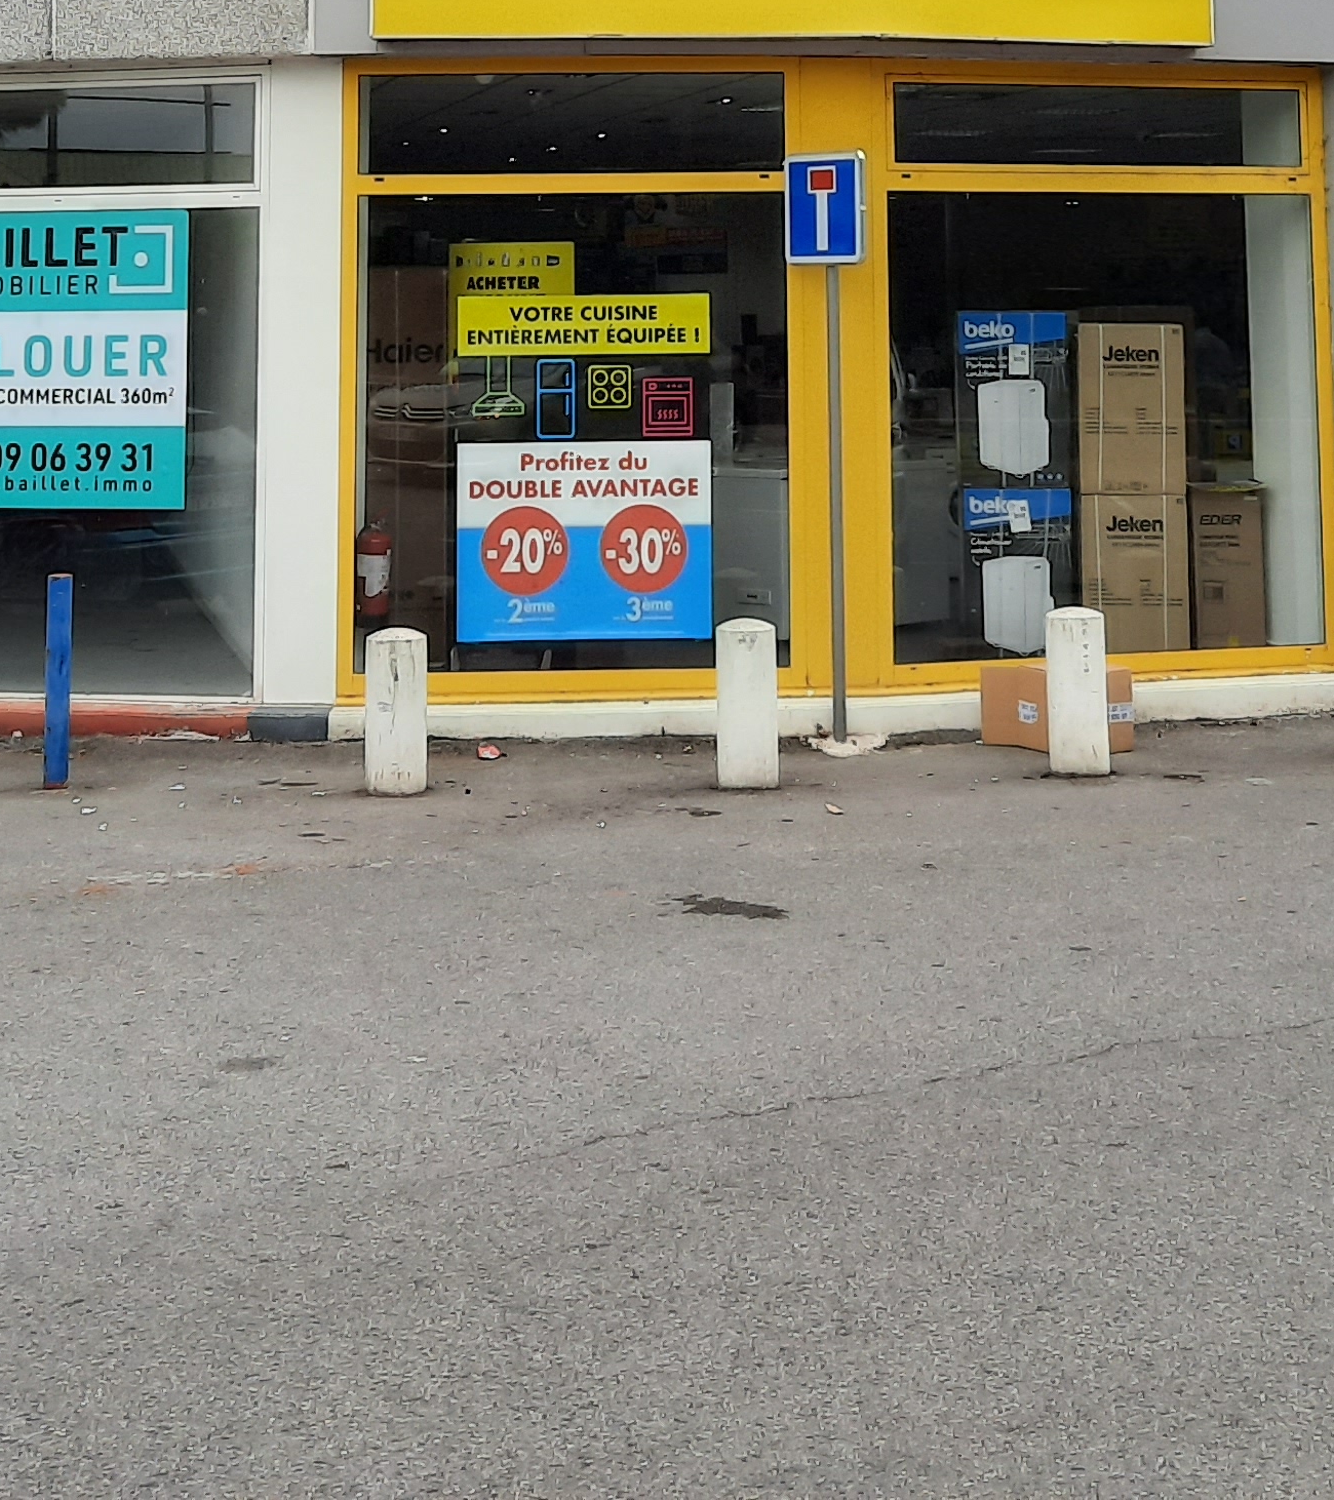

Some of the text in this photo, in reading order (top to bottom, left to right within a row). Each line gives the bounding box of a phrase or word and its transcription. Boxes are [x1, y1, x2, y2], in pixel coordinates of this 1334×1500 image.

[466, 276, 541, 290] ACHETER
[509, 304, 658, 323] VOTRE CUISINE
[467, 325, 599, 346] ENTIÈREMENT
[606, 322, 687, 345] ÉQUIPÉE
[964, 320, 1015, 339] beko
[1102, 345, 1159, 362] Jeken
[31, 443, 66, 472] 06
[75, 443, 111, 472] 39
[121, 443, 153, 472] 31
[520, 451, 648, 473] Profitez du
[469, 477, 700, 500] DOUBLE AVANTAGE
[1106, 516, 1164, 532] Jeken
[485, 528, 682, 575] -20% -30%
